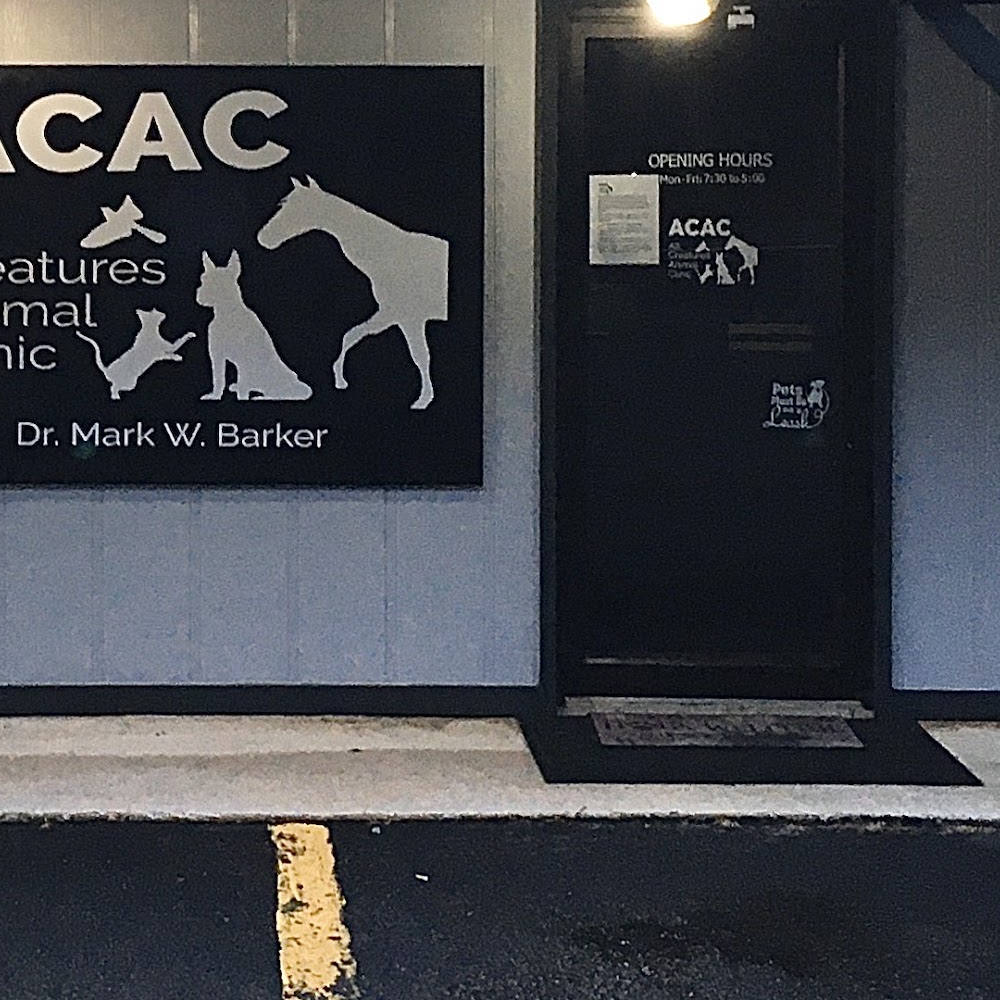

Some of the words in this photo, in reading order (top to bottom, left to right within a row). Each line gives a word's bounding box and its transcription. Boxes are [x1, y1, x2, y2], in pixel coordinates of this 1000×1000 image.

[648, 153, 714, 169] OPENING
[718, 153, 774, 168] HOURS
[668, 218, 732, 237] ACAC
[17, 421, 60, 447] Dr.
[71, 421, 156, 448] Mark
[163, 422, 206, 447] W.
[218, 421, 329, 449] Barker
